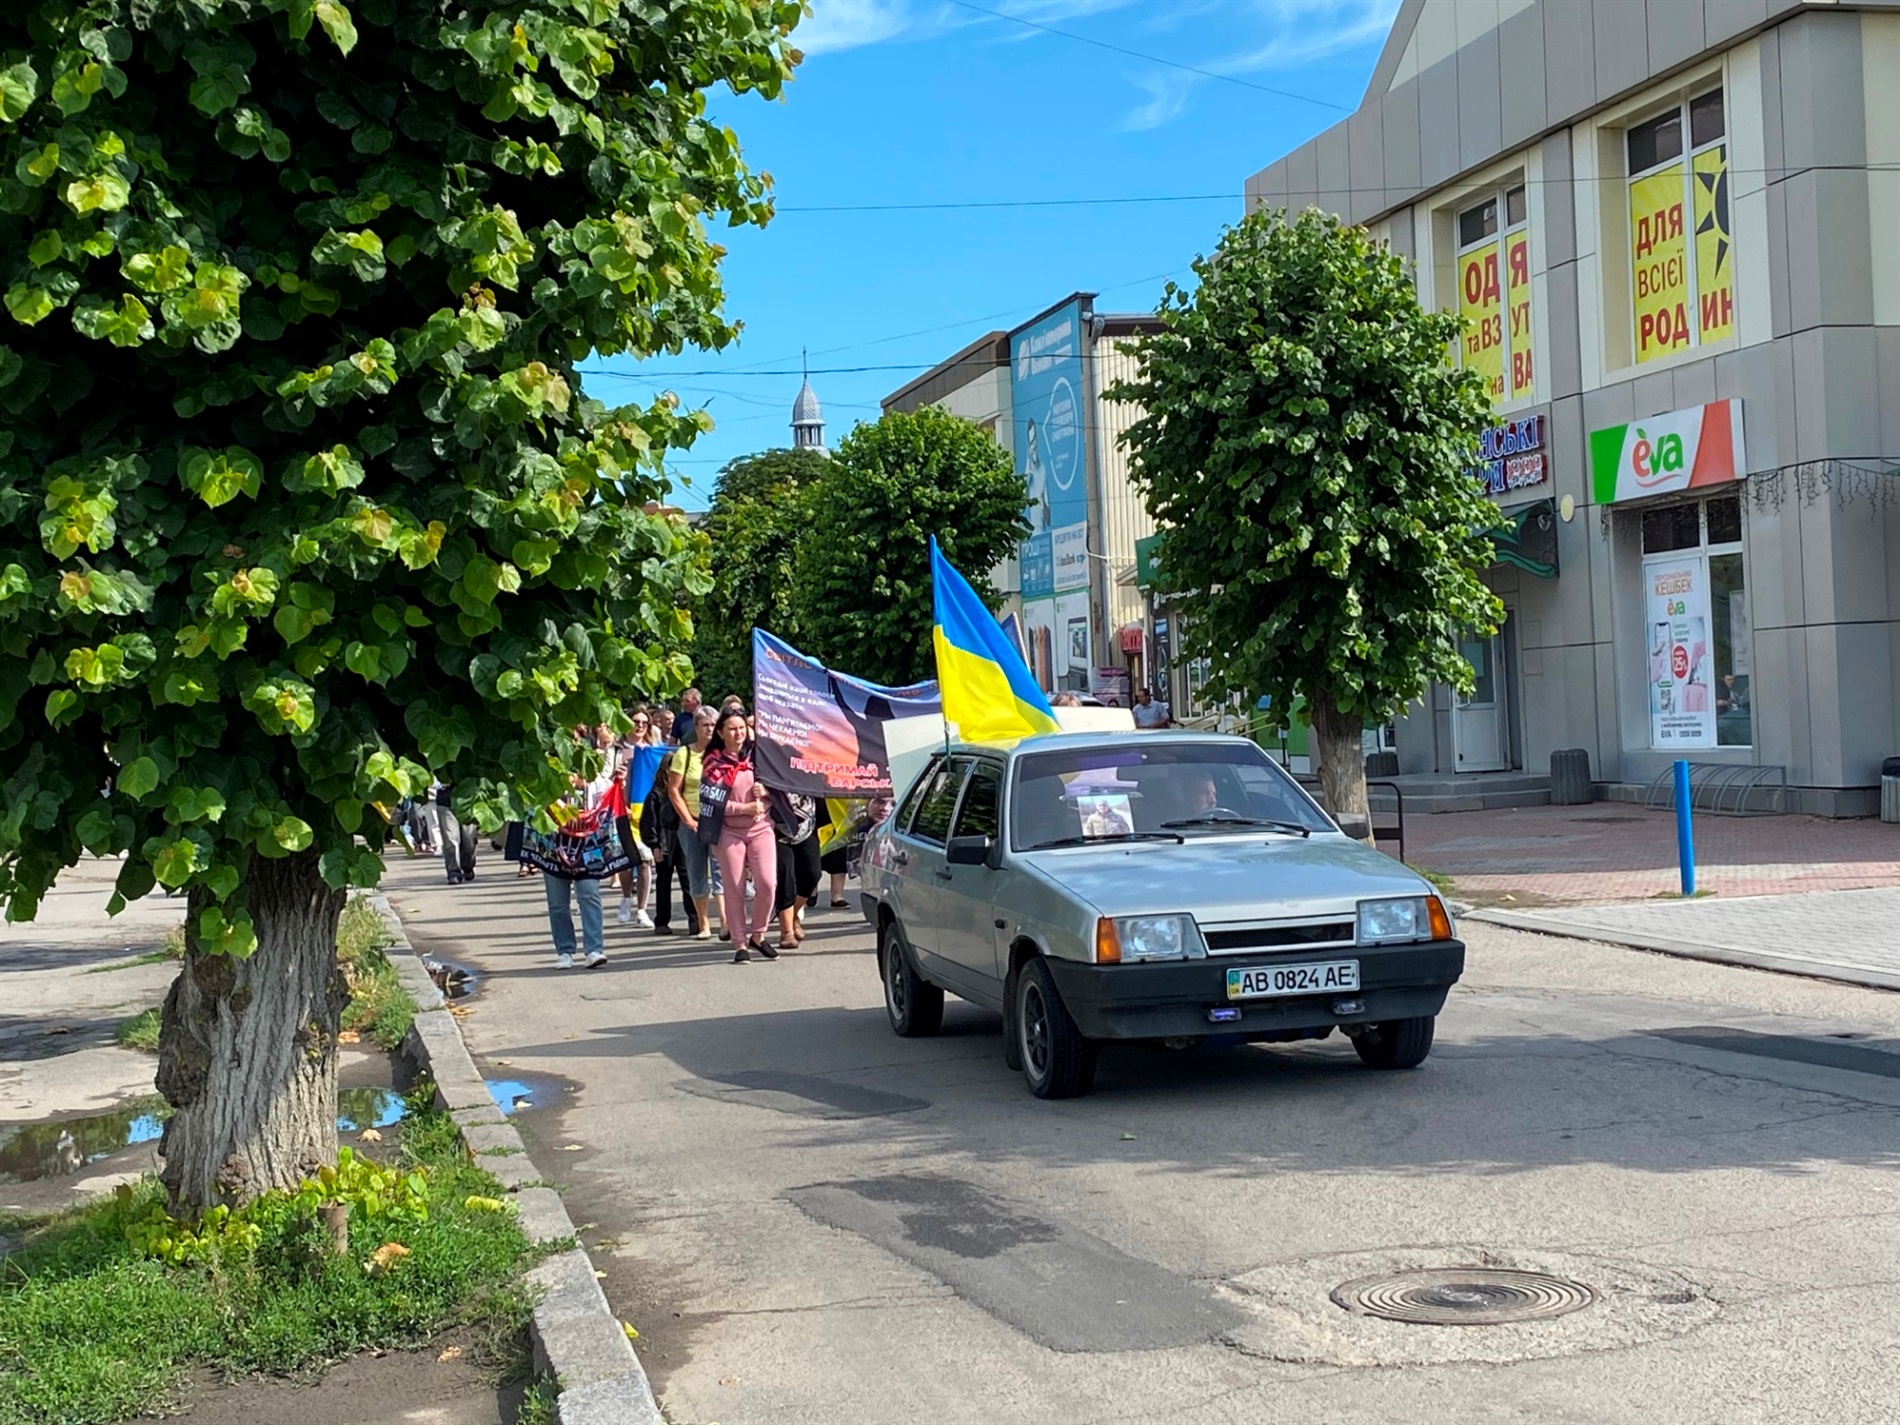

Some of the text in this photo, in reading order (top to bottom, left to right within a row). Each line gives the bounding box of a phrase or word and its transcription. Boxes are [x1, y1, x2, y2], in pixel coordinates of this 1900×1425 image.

[1636, 202, 1683, 260] ДЛЯ
[1638, 247, 1683, 299] ВСІЄЇ
[1467, 333, 1479, 355] та
[1655, 579, 1693, 596] КЕШБЕК
[790, 757, 878, 777] ПІДТРИМАЙ
[831, 778, 892, 791] БАРСЬК
[1242, 966, 1352, 993] AB 0824 AE
